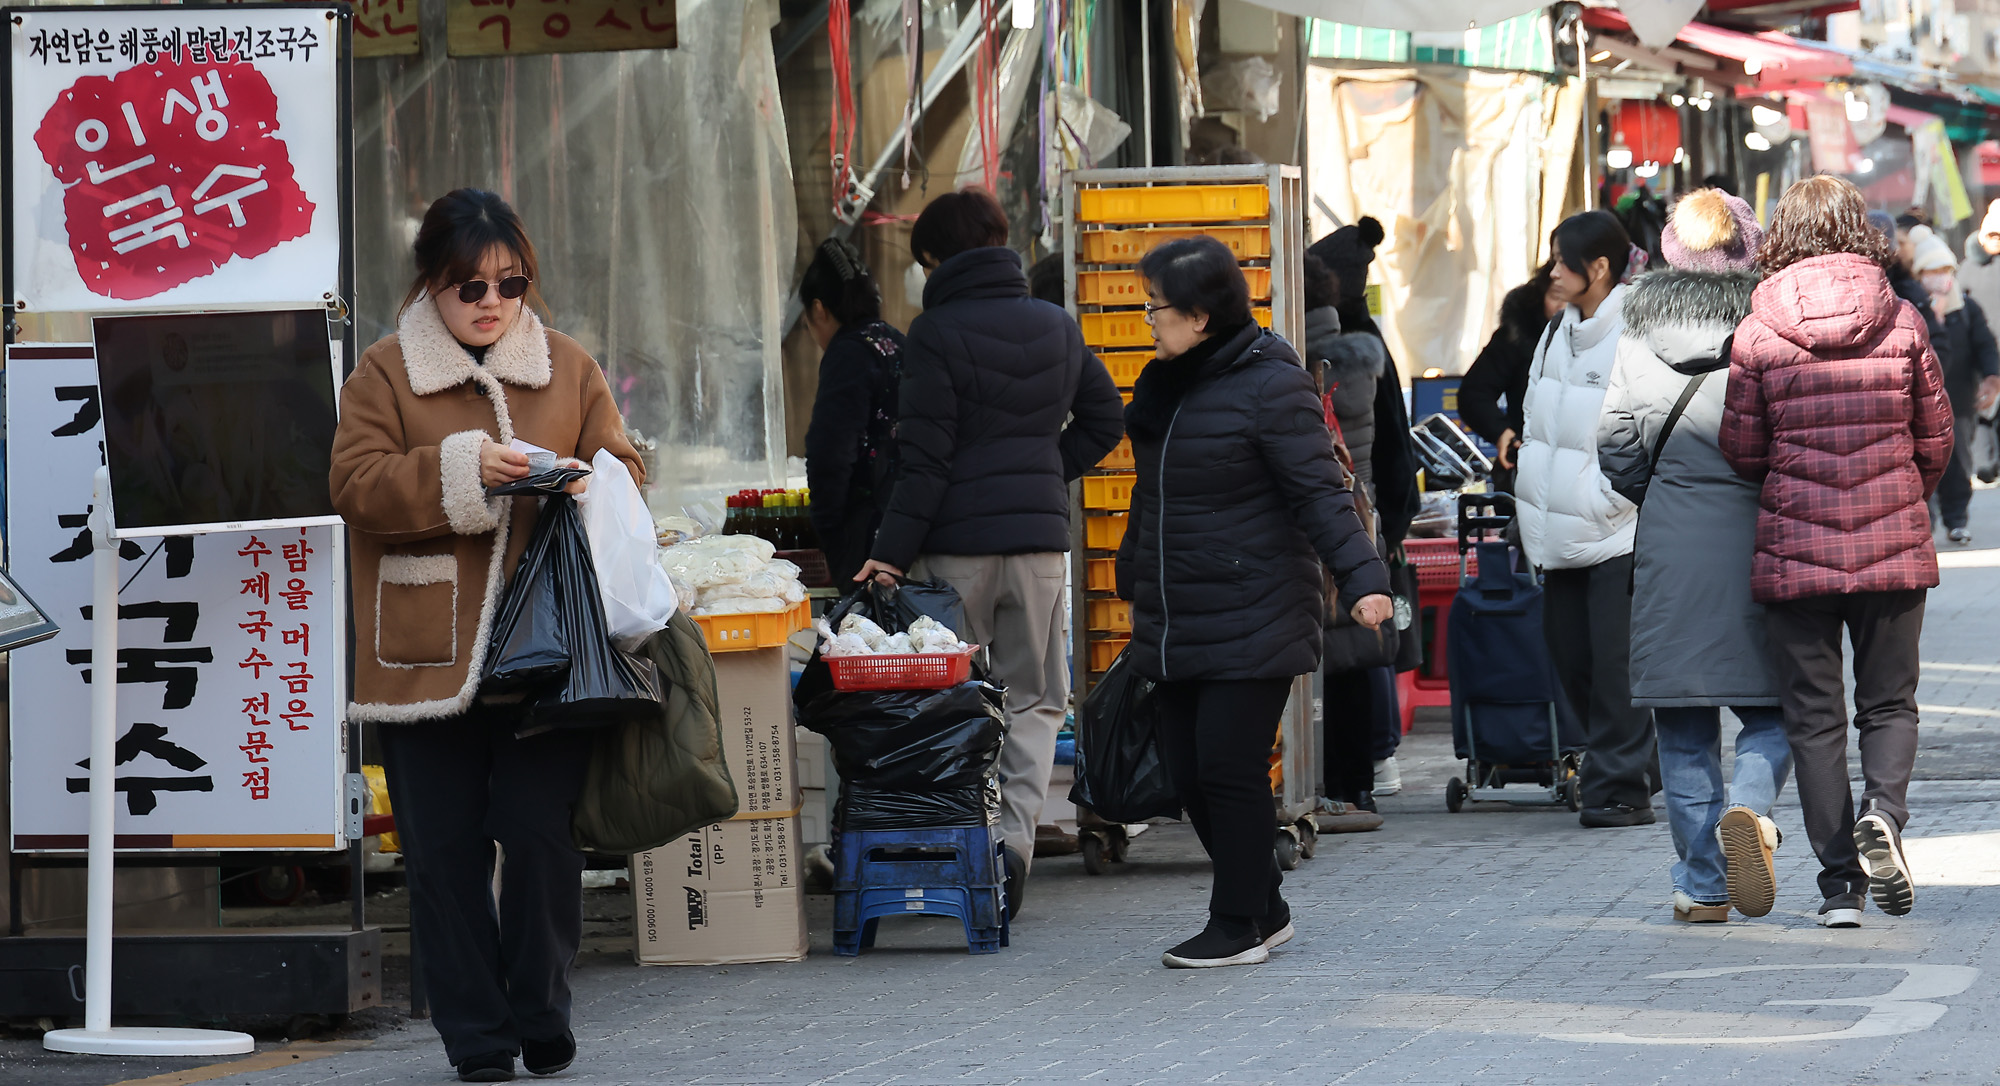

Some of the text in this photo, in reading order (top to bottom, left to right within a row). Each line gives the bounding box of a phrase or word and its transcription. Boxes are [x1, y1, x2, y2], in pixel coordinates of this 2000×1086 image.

[29, 28, 115, 66] 자연담은
[118, 27, 182, 65] 해풍에
[75, 69, 230, 185] 인생
[102, 164, 269, 255] 국수
[279, 527, 314, 731] 람을 머금은
[238, 535, 274, 801] 수제국수 전문점
[744, 707, 752, 725] 53-22
[759, 742, 768, 769] 634-107
[771, 725, 782, 782] 031-358-8754
[775, 788, 783, 801] Fax
[712, 821, 723, 831] P
[751, 834, 760, 853] 경기도
[776, 817, 787, 868] 031-358-875
[687, 838, 703, 877] Total
[645, 877, 654, 901] 14000
[780, 874, 788, 886] Tel
[646, 909, 656, 928] 9000
[648, 929, 657, 942] ISO
